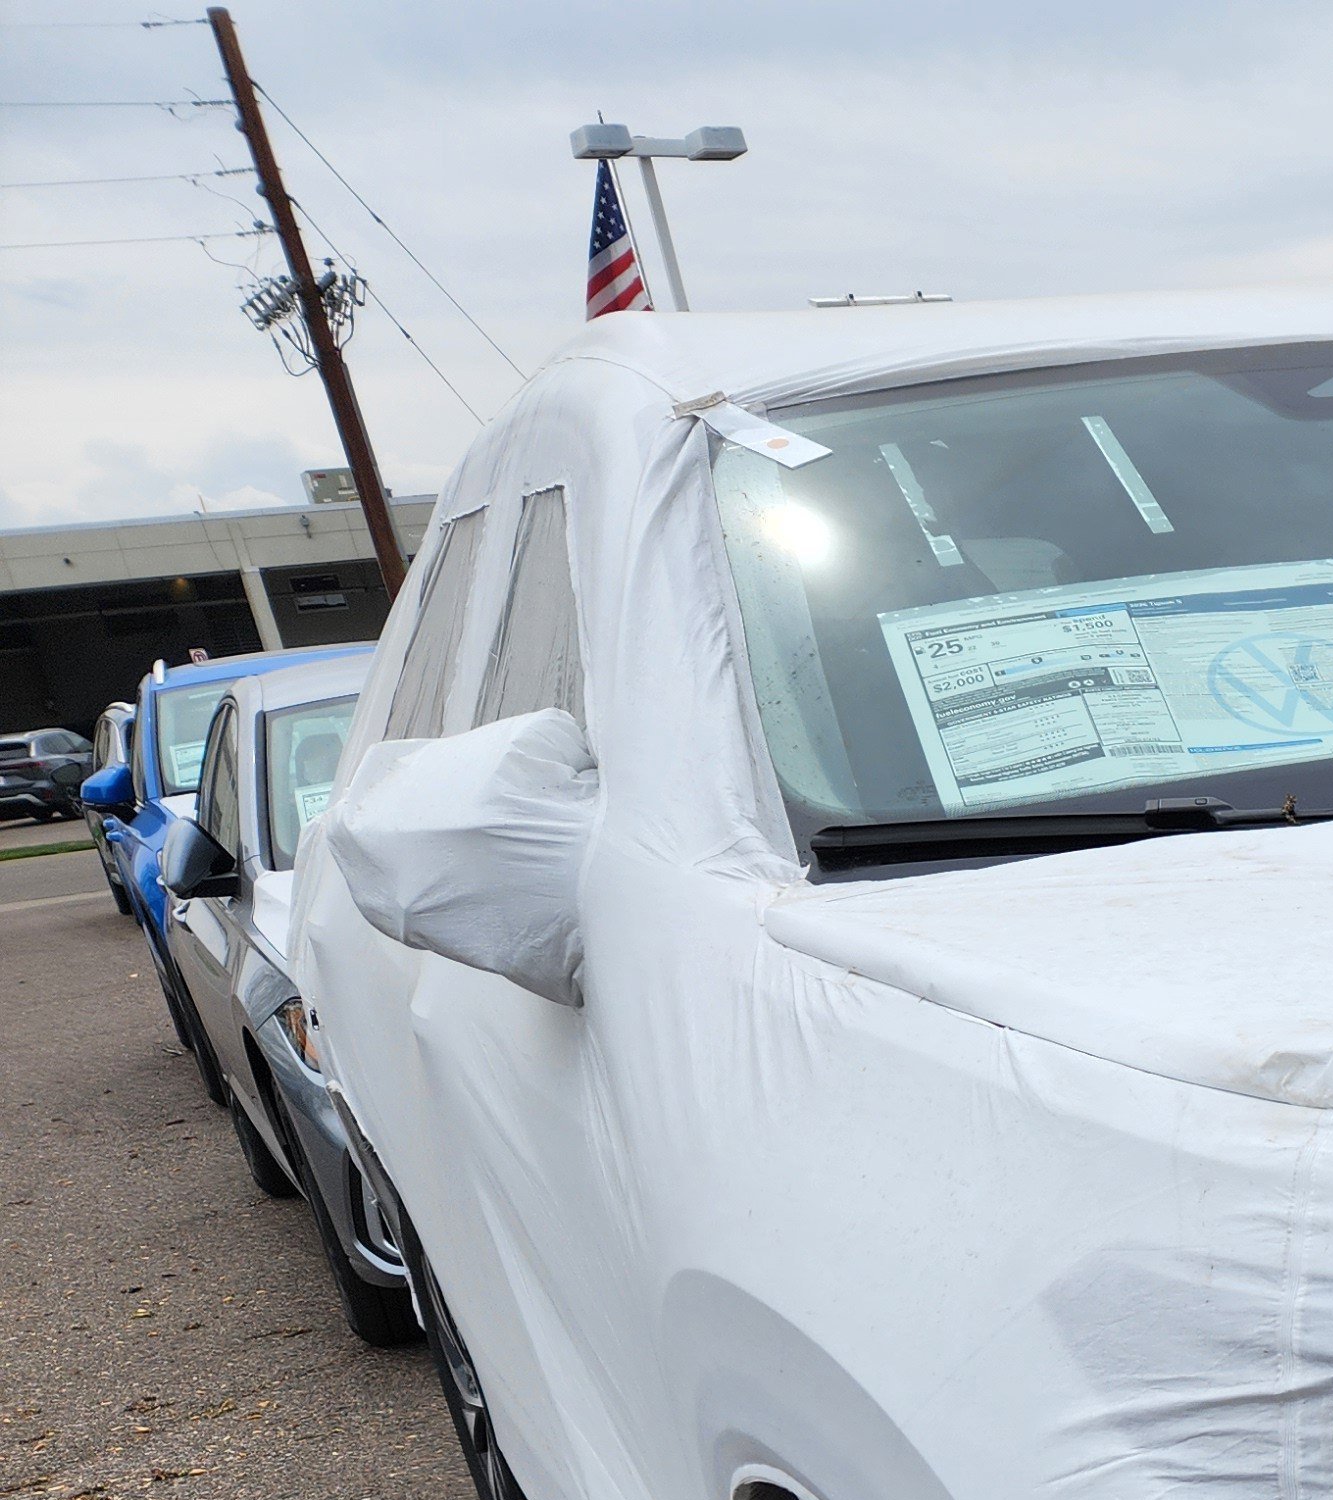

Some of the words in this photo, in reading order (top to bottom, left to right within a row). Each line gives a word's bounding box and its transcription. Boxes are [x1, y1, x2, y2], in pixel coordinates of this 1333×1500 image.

[927, 638, 964, 659] 25
[932, 674, 985, 694] $2,000
[935, 694, 1017, 719] fueleconomy.gov
